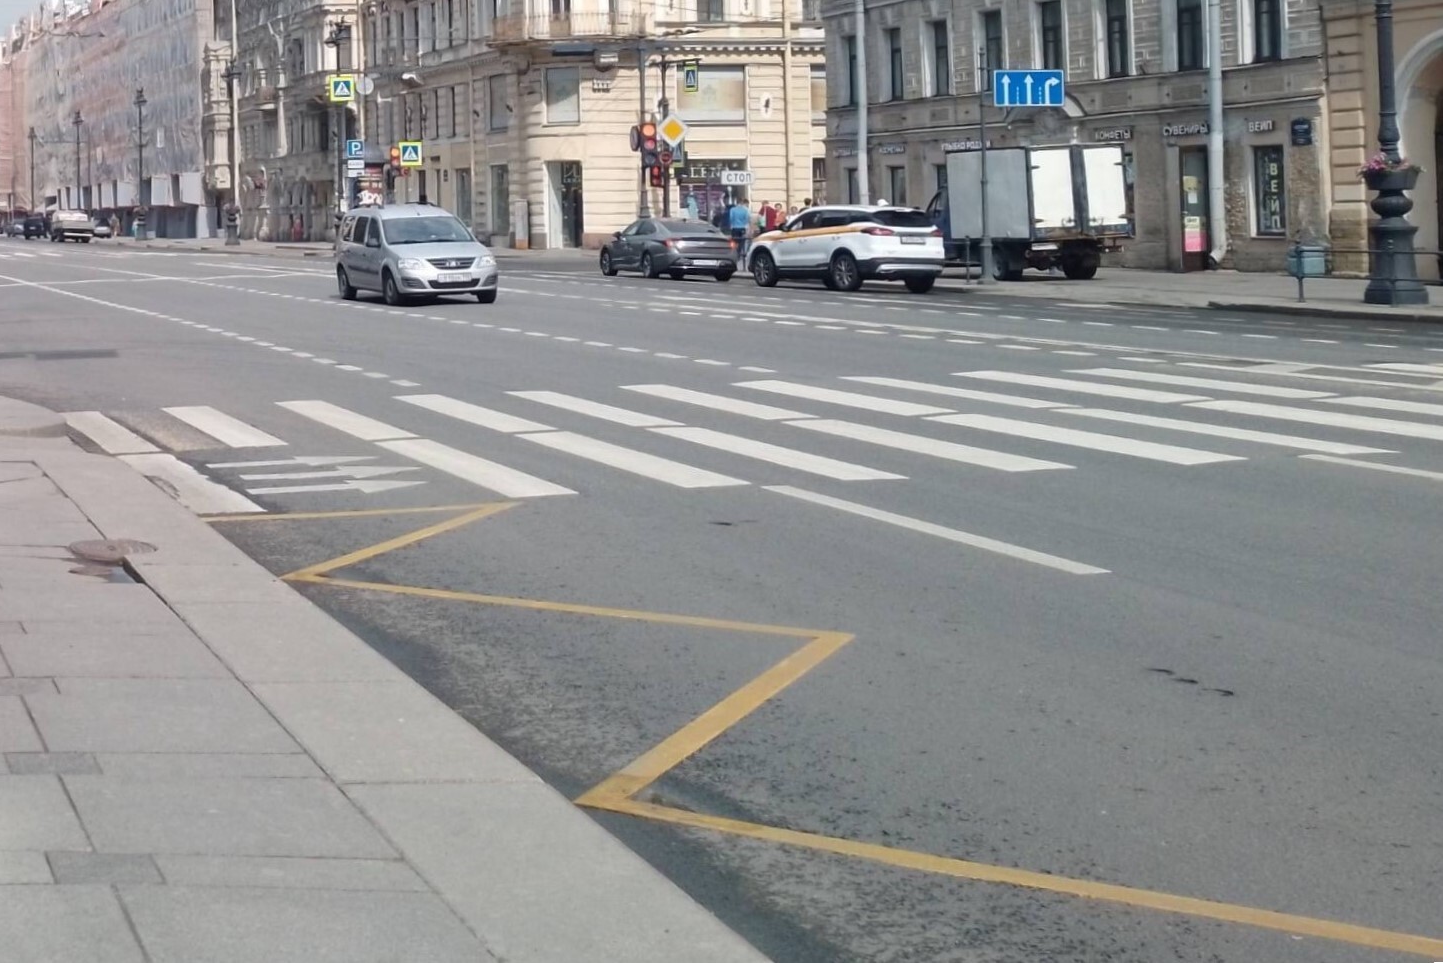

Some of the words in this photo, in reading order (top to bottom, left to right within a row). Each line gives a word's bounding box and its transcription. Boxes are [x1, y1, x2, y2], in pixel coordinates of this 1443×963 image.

[1162, 122, 1210, 136] СУВЕНИРЫ
[351, 142, 362, 155] P
[726, 171, 752, 183] СТОП
